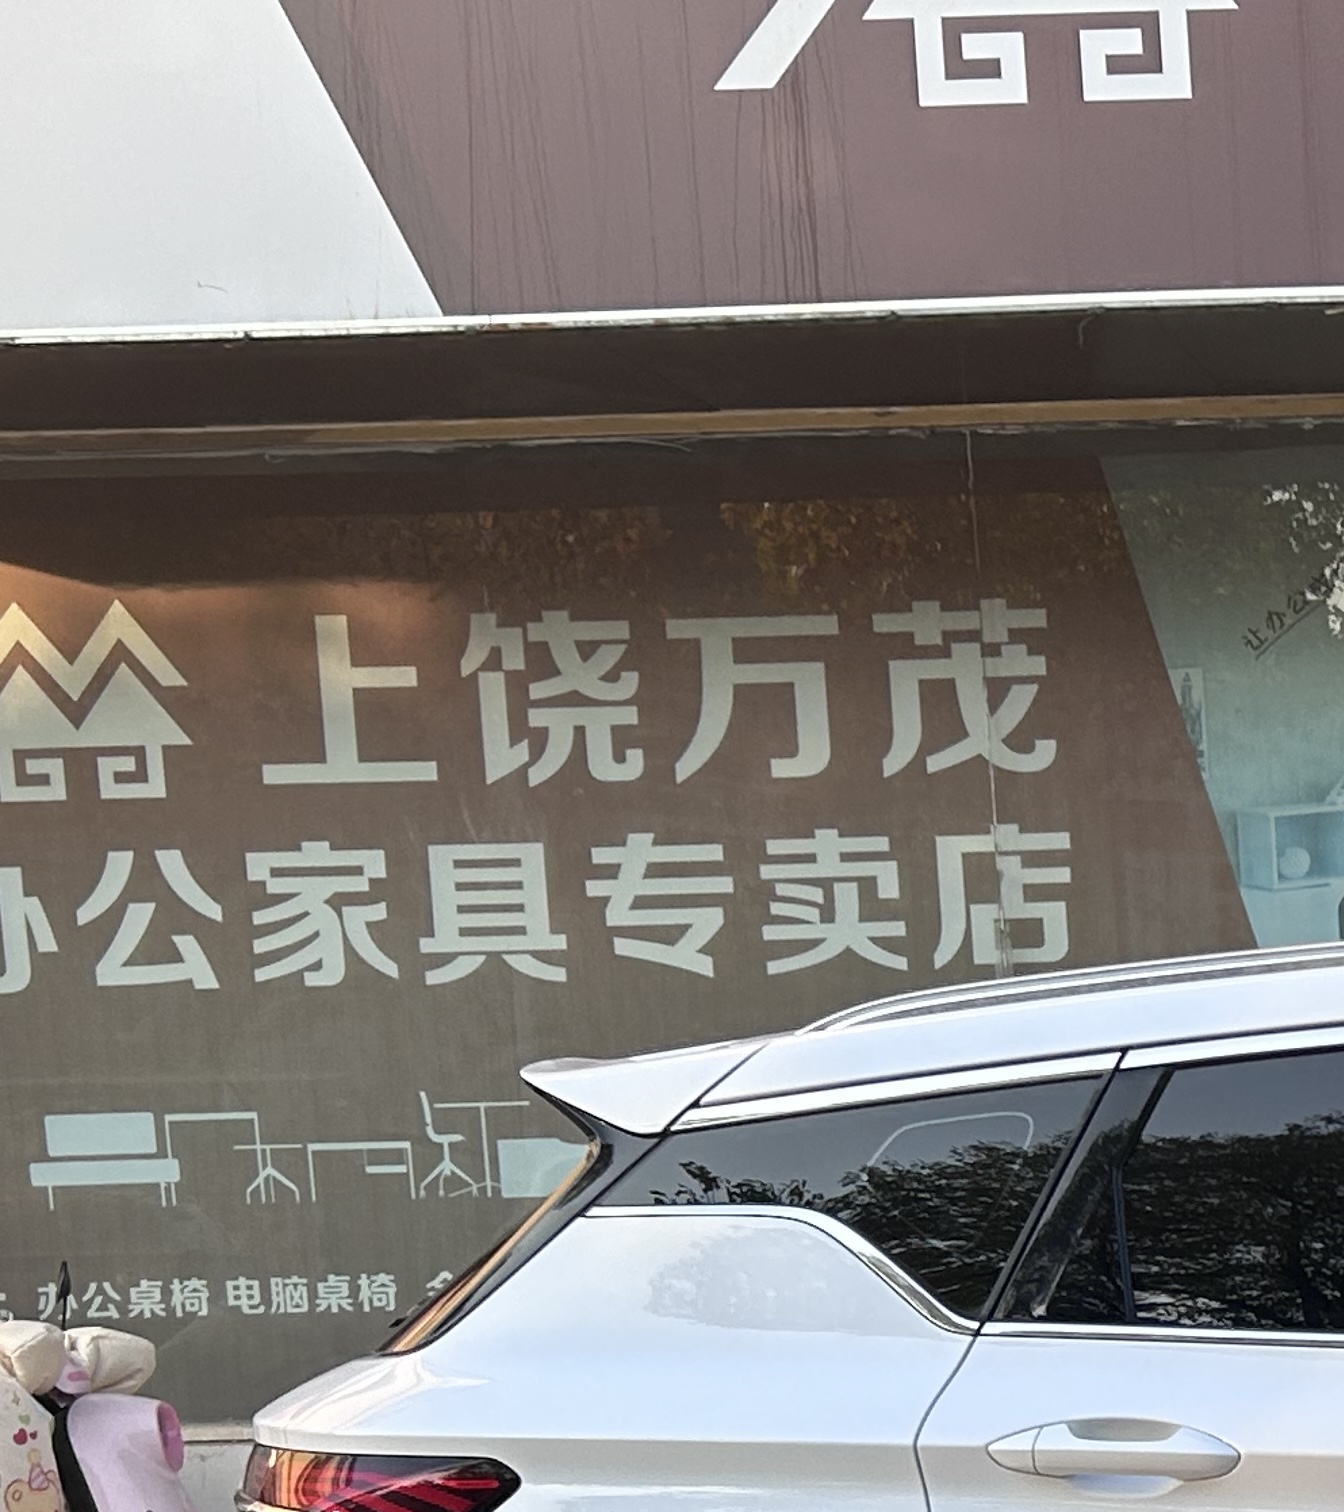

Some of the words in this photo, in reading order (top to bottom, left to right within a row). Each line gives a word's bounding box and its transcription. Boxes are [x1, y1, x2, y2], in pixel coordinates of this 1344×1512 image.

[262, 598, 1058, 788] 上饶万茂
[37, 1276, 210, 1321] 办公桌椅
[225, 1271, 397, 1316] 电脑桌椅
